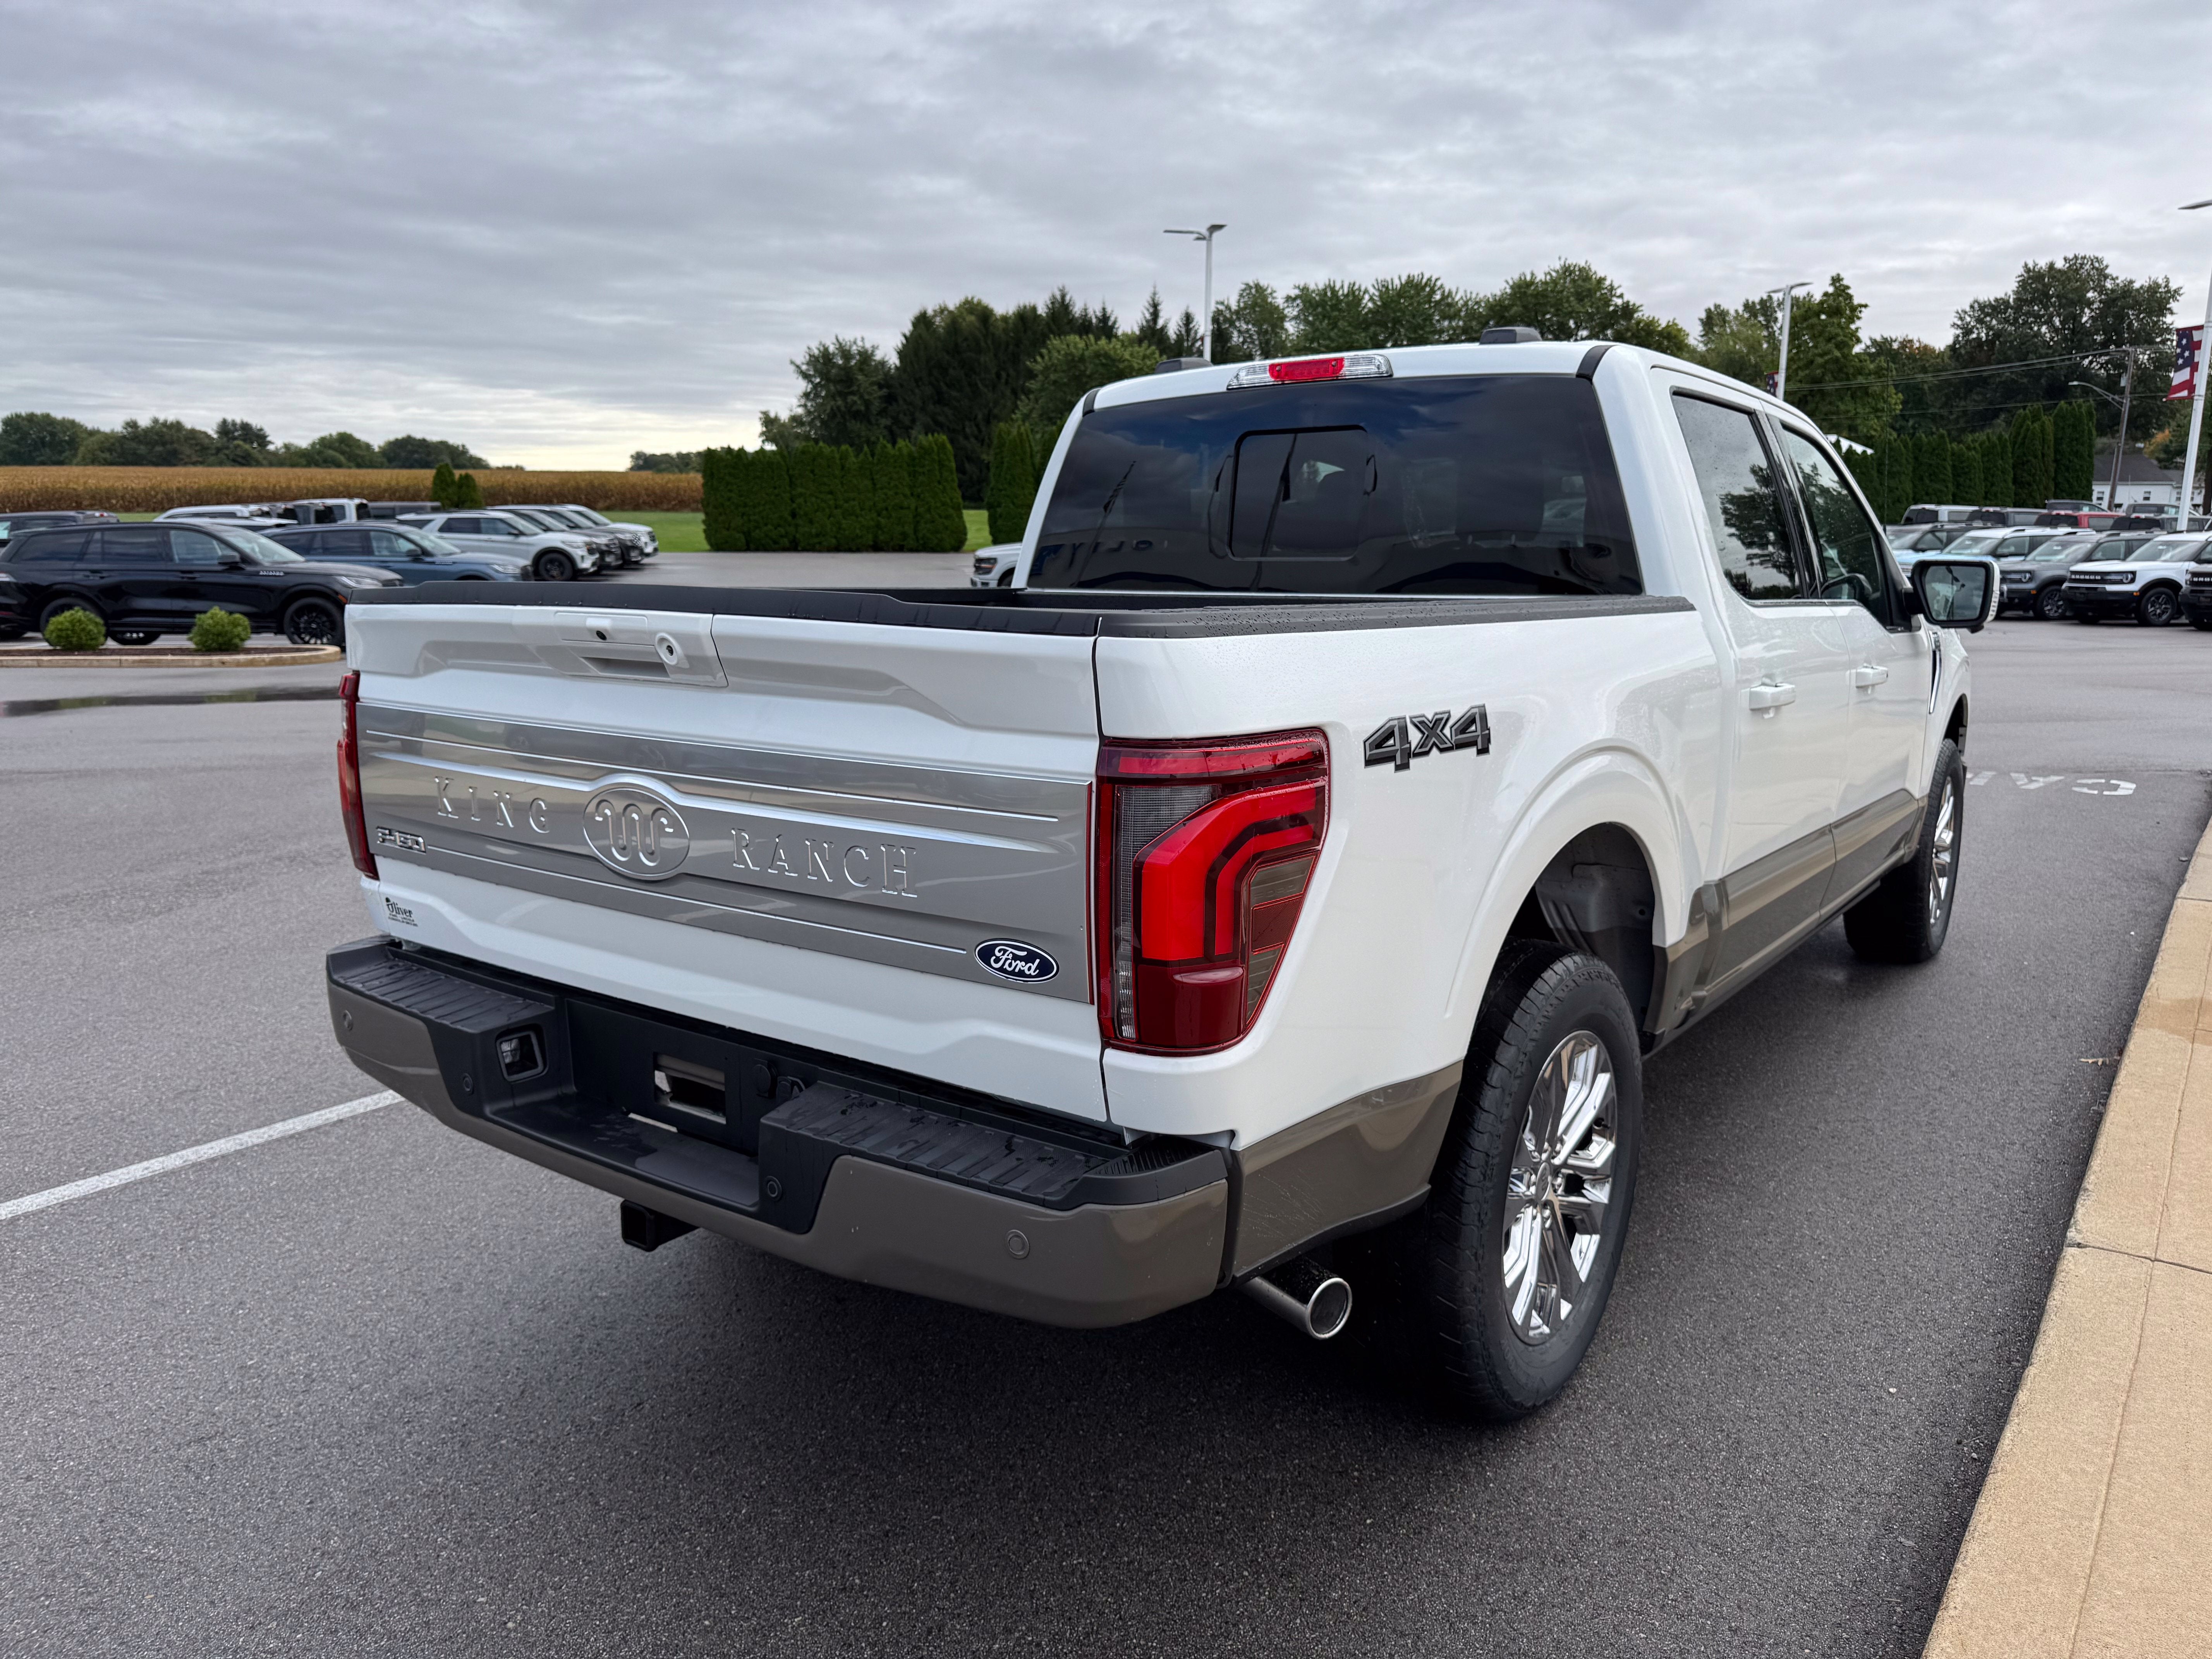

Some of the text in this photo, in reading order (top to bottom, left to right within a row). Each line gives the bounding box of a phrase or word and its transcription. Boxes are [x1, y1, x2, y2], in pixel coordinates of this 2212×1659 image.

[434, 776, 917, 898] KING RANCH
[990, 946, 1040, 975] Ford
